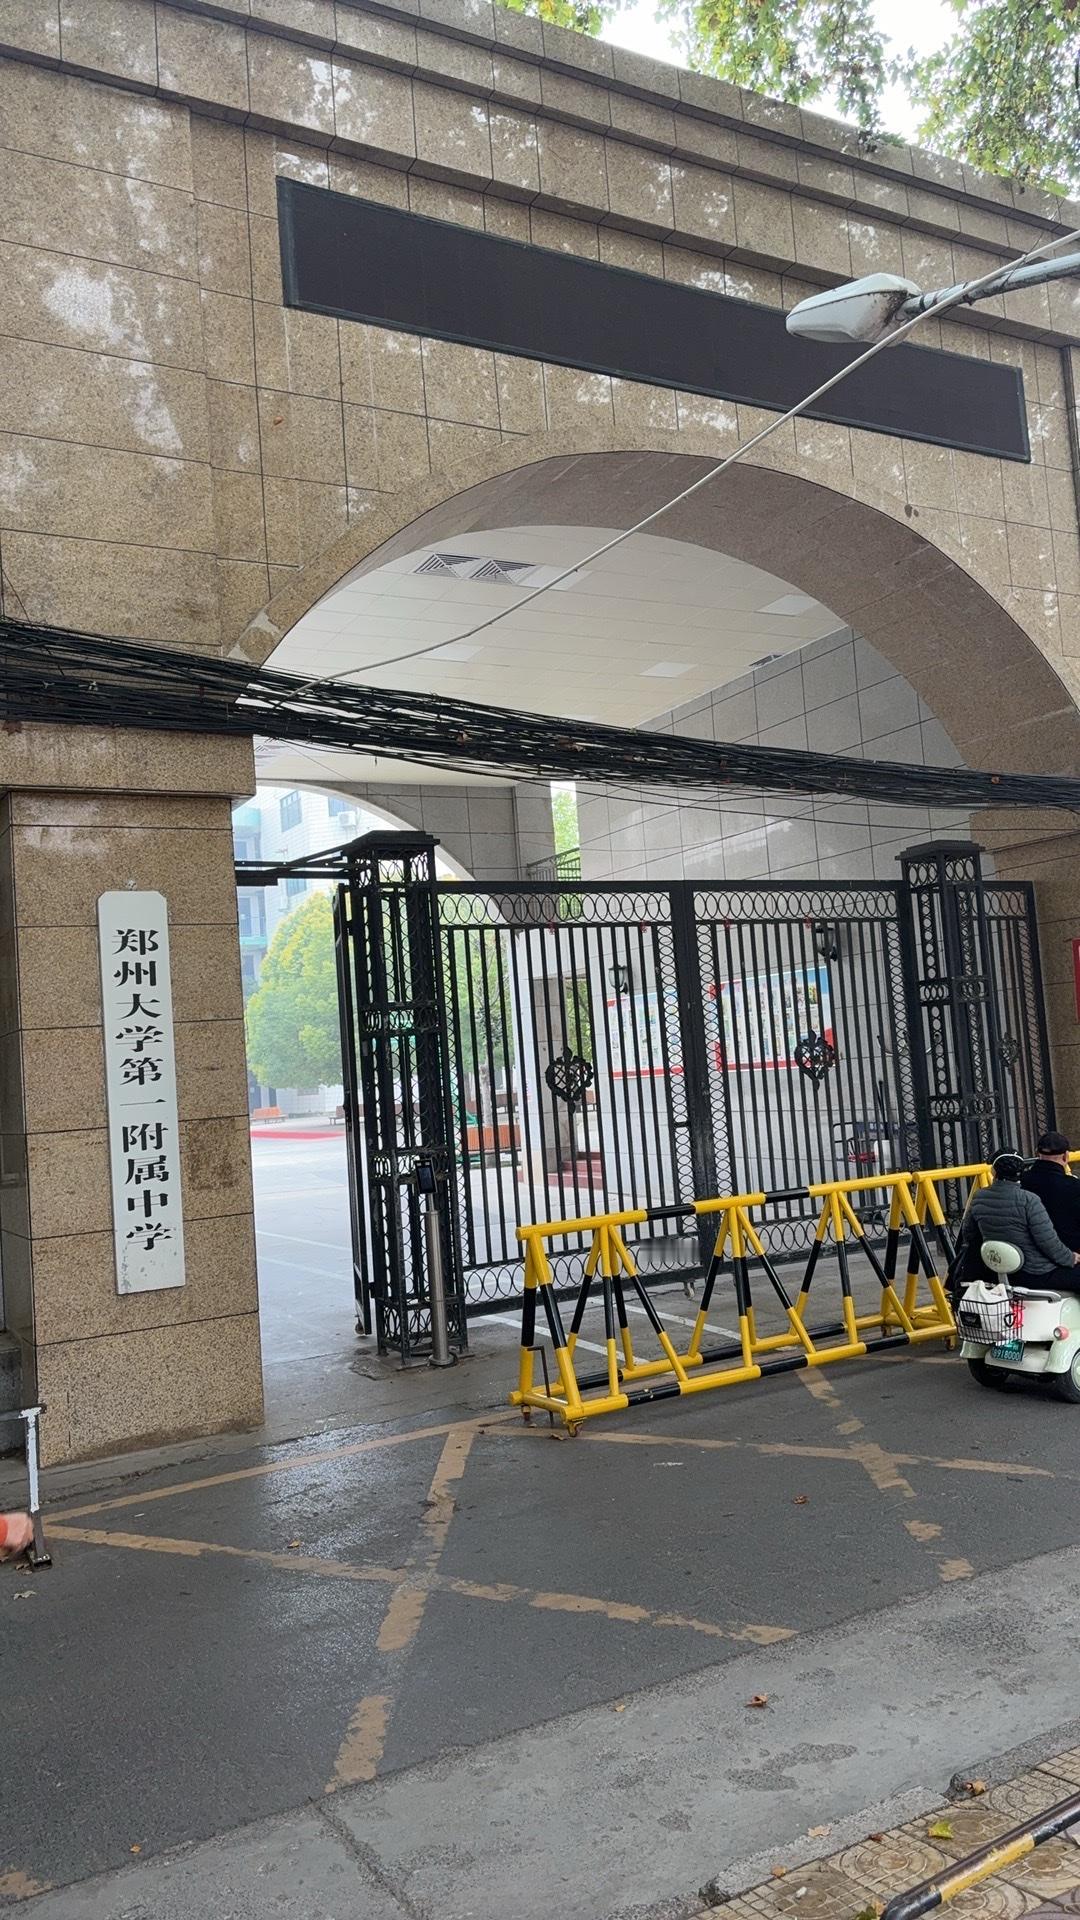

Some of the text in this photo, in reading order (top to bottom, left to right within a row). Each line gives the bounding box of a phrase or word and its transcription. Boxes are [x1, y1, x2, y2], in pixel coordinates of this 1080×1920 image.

[112, 929, 173, 1251] 郑州大学第一附属中学
